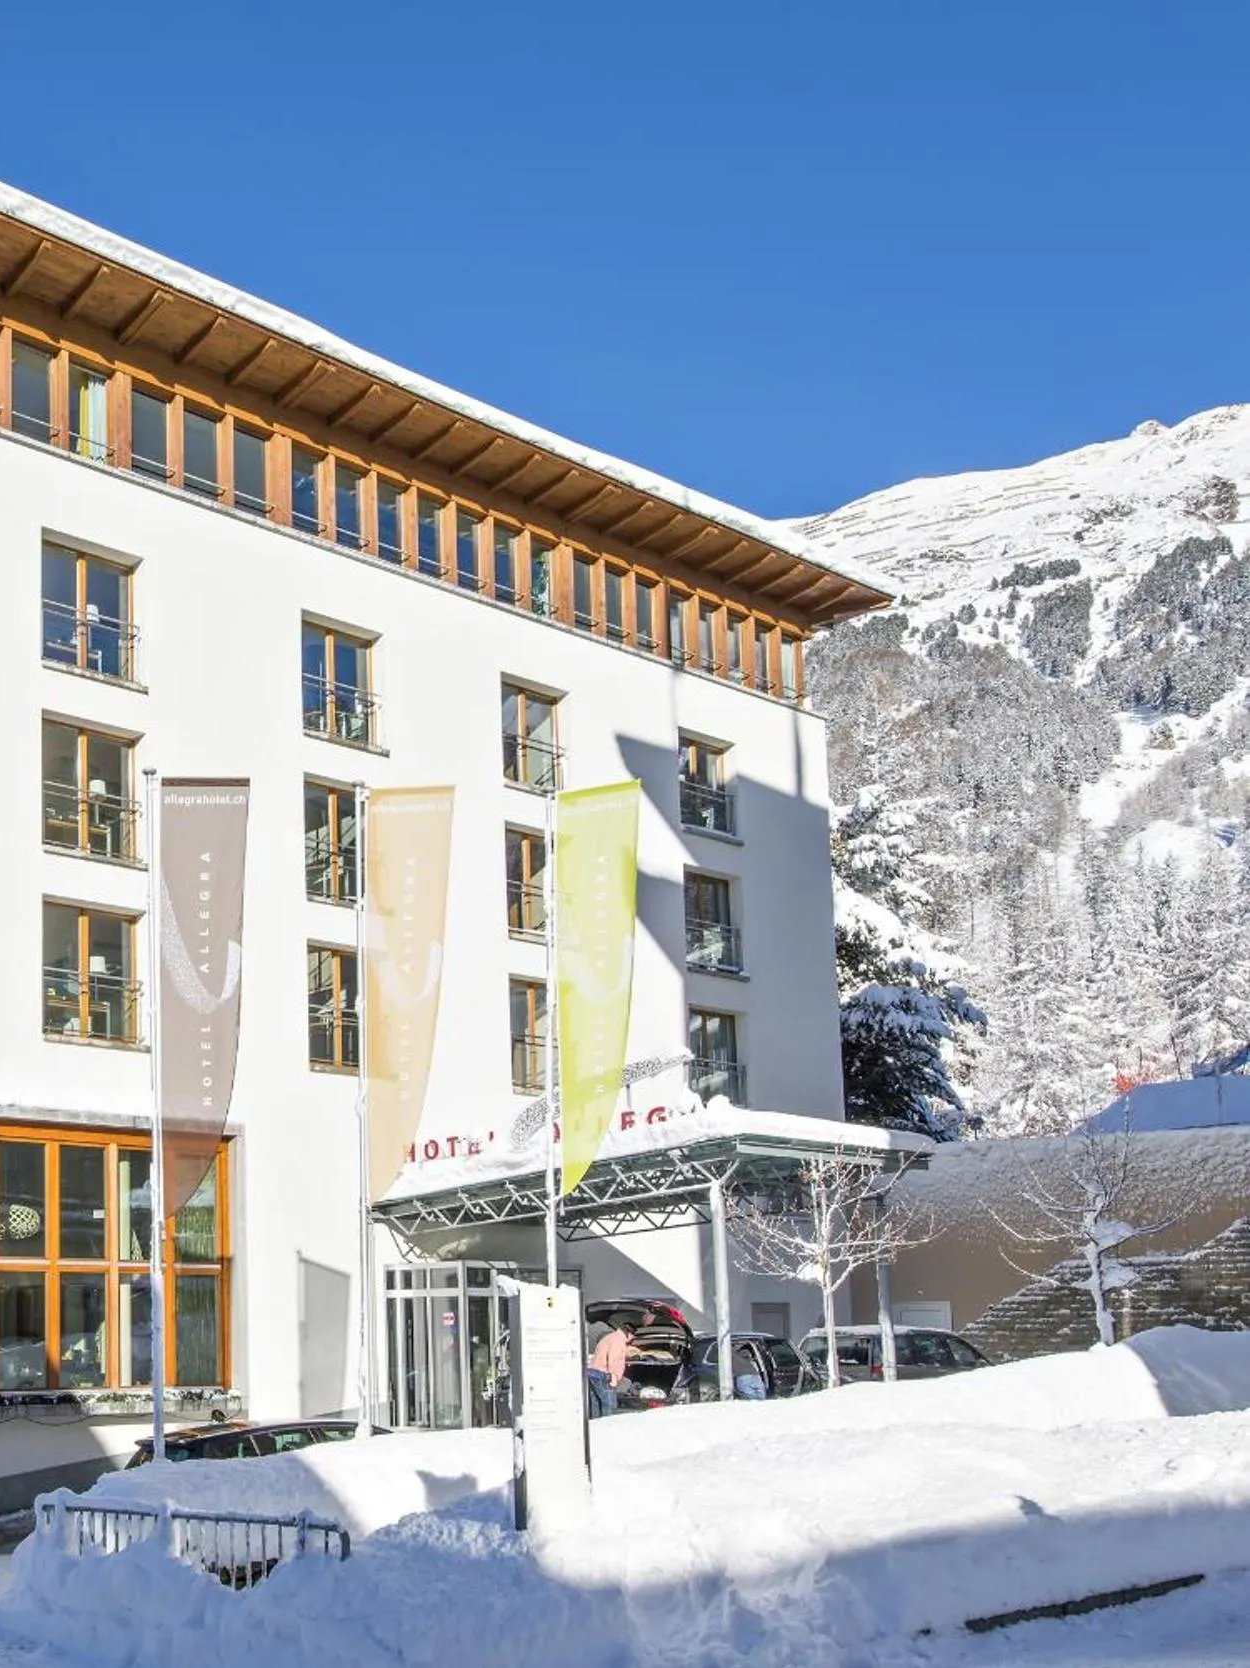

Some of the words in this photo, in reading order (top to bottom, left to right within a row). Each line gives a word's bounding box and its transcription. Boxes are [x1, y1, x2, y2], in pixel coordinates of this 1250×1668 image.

[164, 793, 246, 806] allegrahotel.ch
[200, 852, 210, 973] ALLEGRA
[201, 1026, 212, 1106] HOTEL
